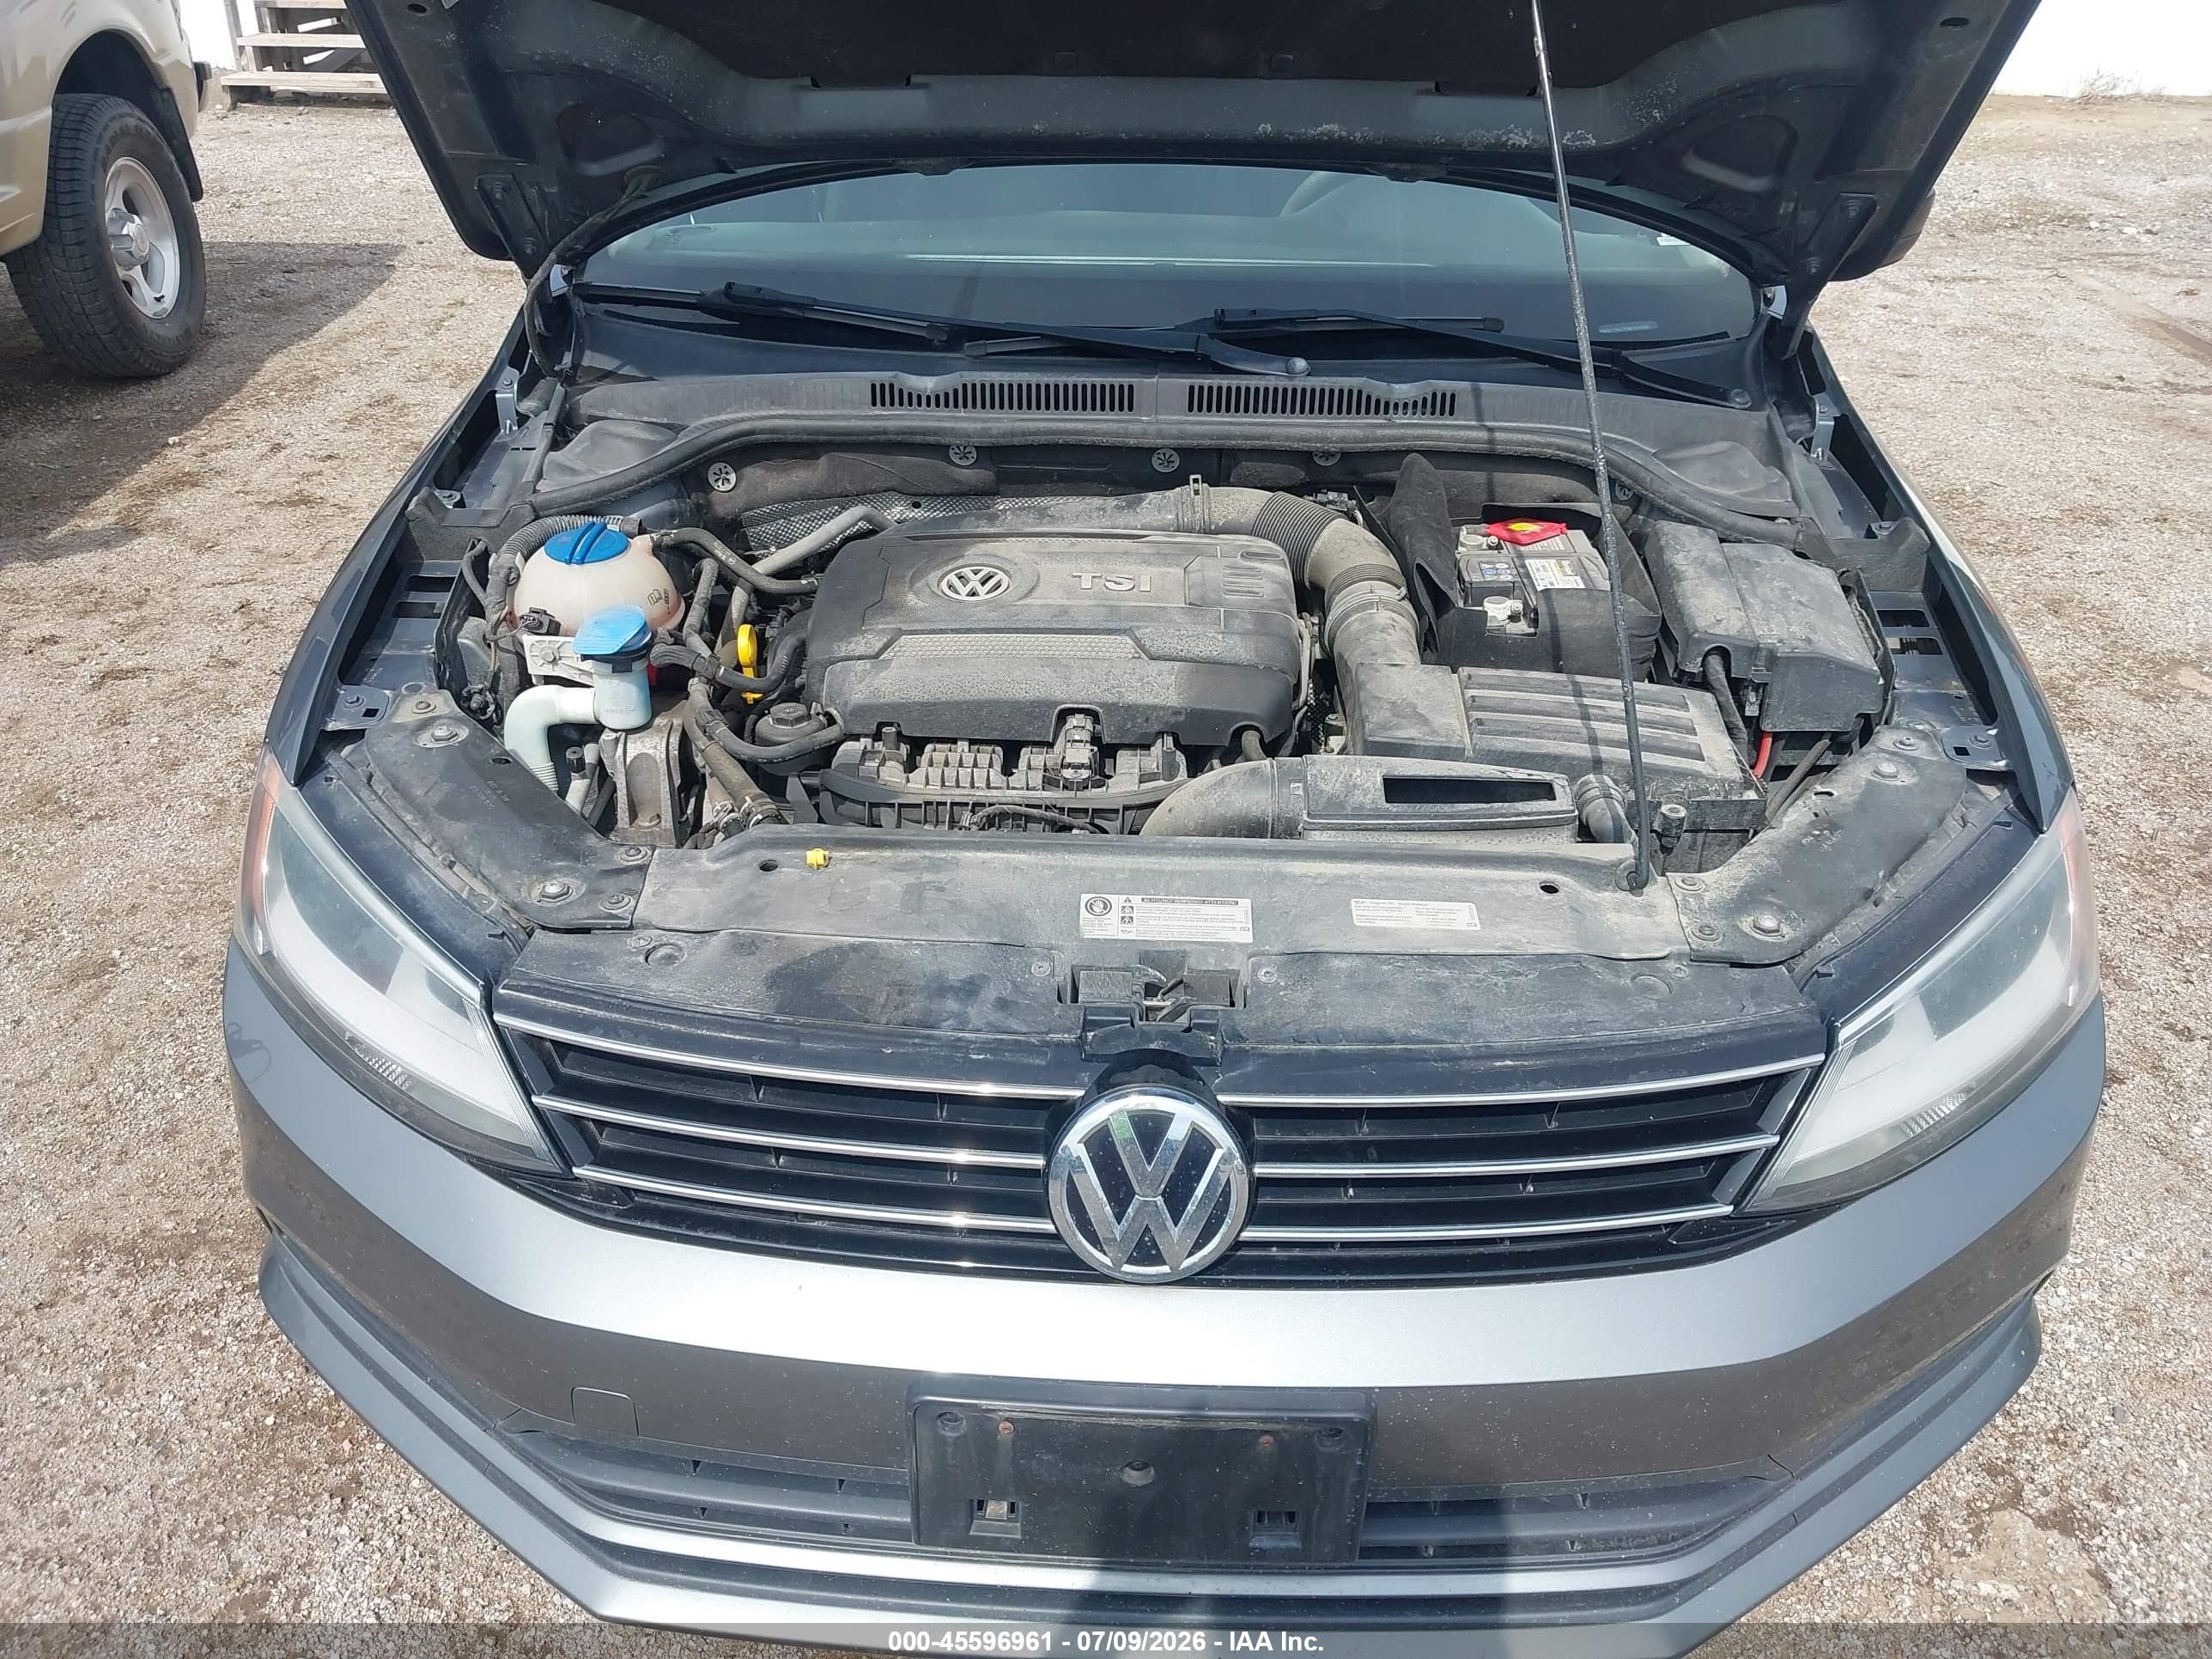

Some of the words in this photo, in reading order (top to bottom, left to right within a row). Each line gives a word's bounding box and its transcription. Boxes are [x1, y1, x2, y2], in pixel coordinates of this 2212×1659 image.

[941, 566, 1012, 601] VW
[1071, 571, 1152, 593] TSI
[1054, 1096, 1242, 1278] VW
